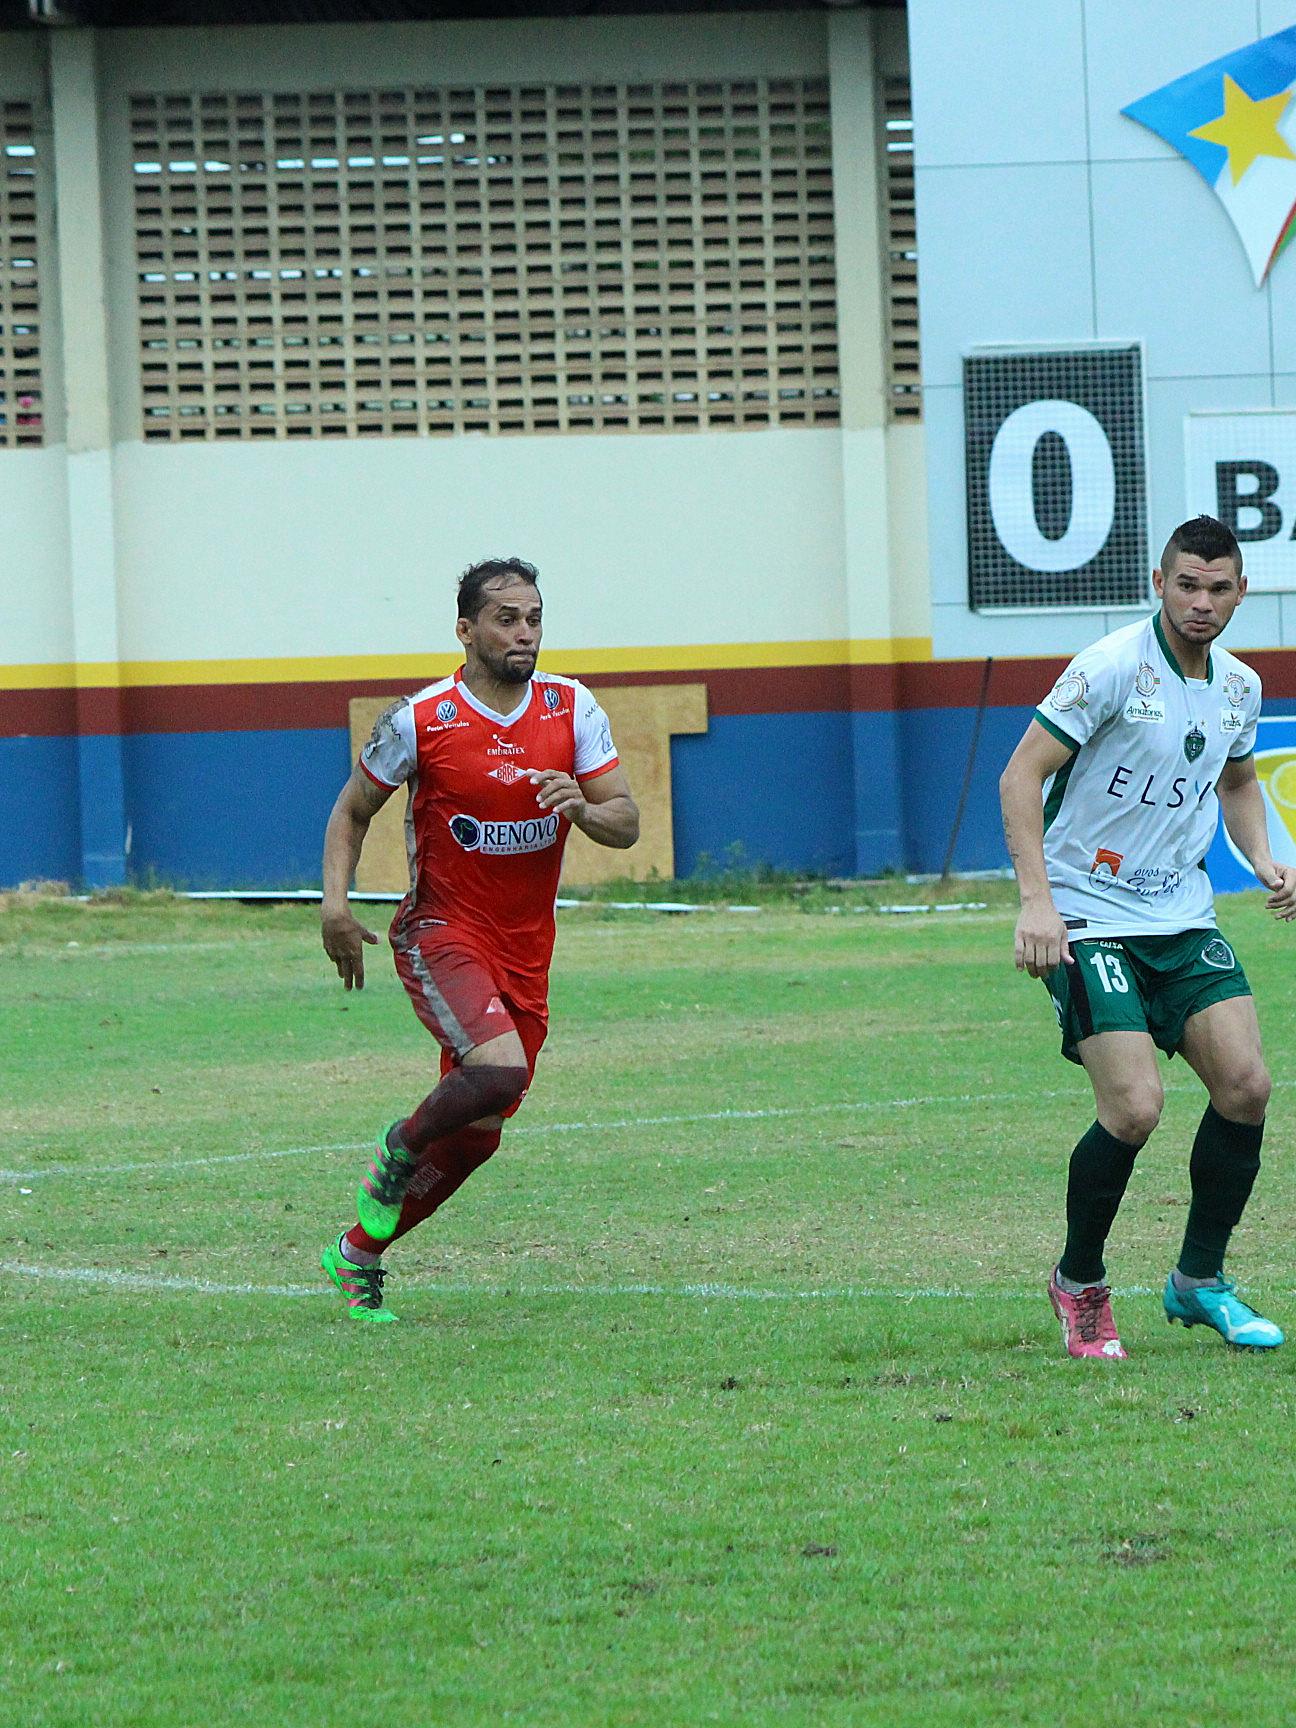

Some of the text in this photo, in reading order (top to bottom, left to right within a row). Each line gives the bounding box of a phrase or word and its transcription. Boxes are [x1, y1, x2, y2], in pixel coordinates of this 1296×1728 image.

[484, 815, 558, 846] RENOVO
[1100, 940, 1124, 950] CAIXA
[1090, 951, 1129, 993] 13
